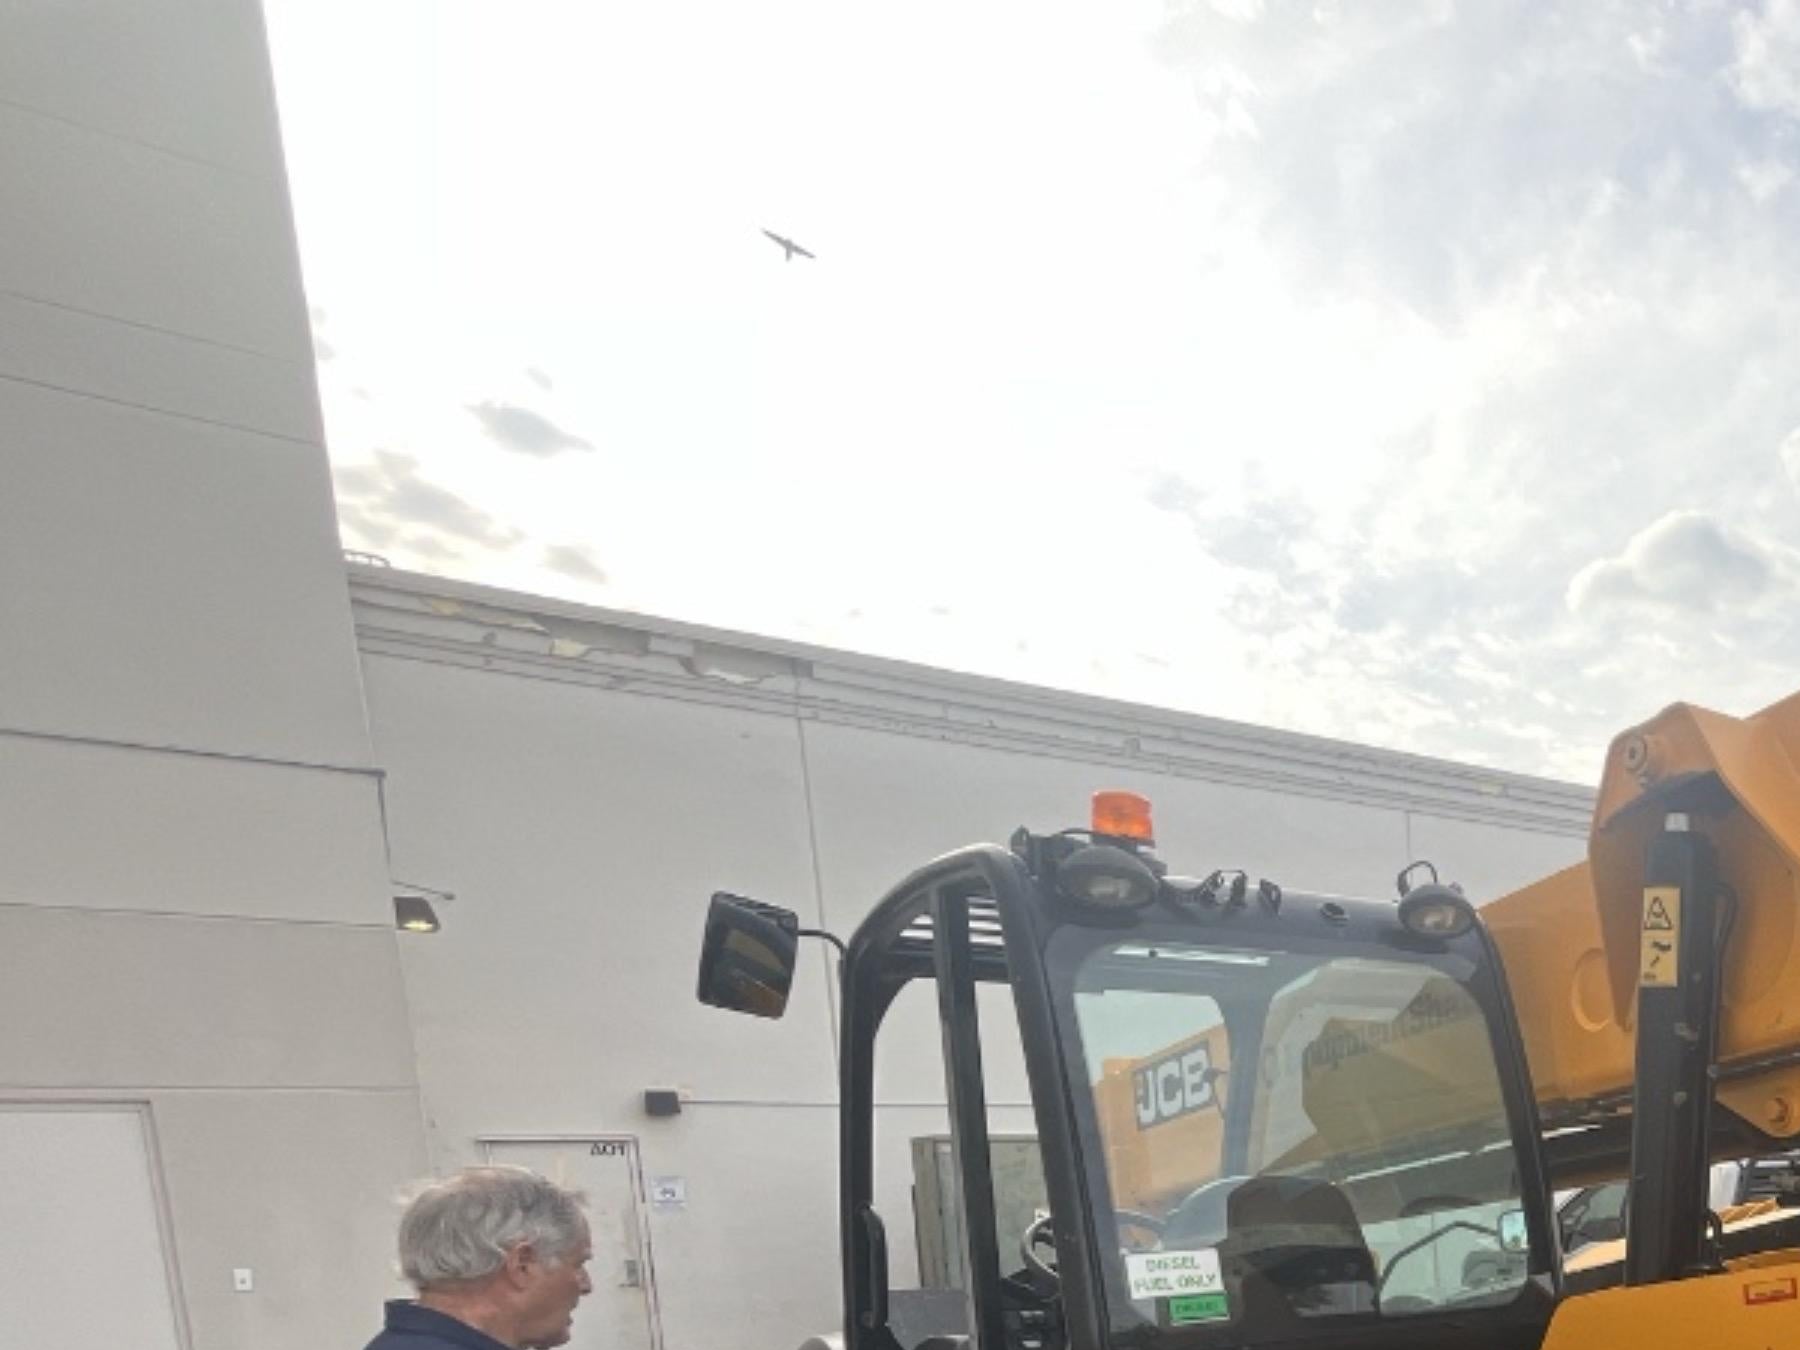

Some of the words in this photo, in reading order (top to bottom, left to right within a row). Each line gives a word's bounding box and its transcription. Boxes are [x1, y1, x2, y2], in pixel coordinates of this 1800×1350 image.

[1136, 1049, 1211, 1122] JCB
[1145, 1256, 1200, 1272] DIESEL
[1134, 1276, 1173, 1293] FUEL
[1177, 1273, 1216, 1289] ONLY
